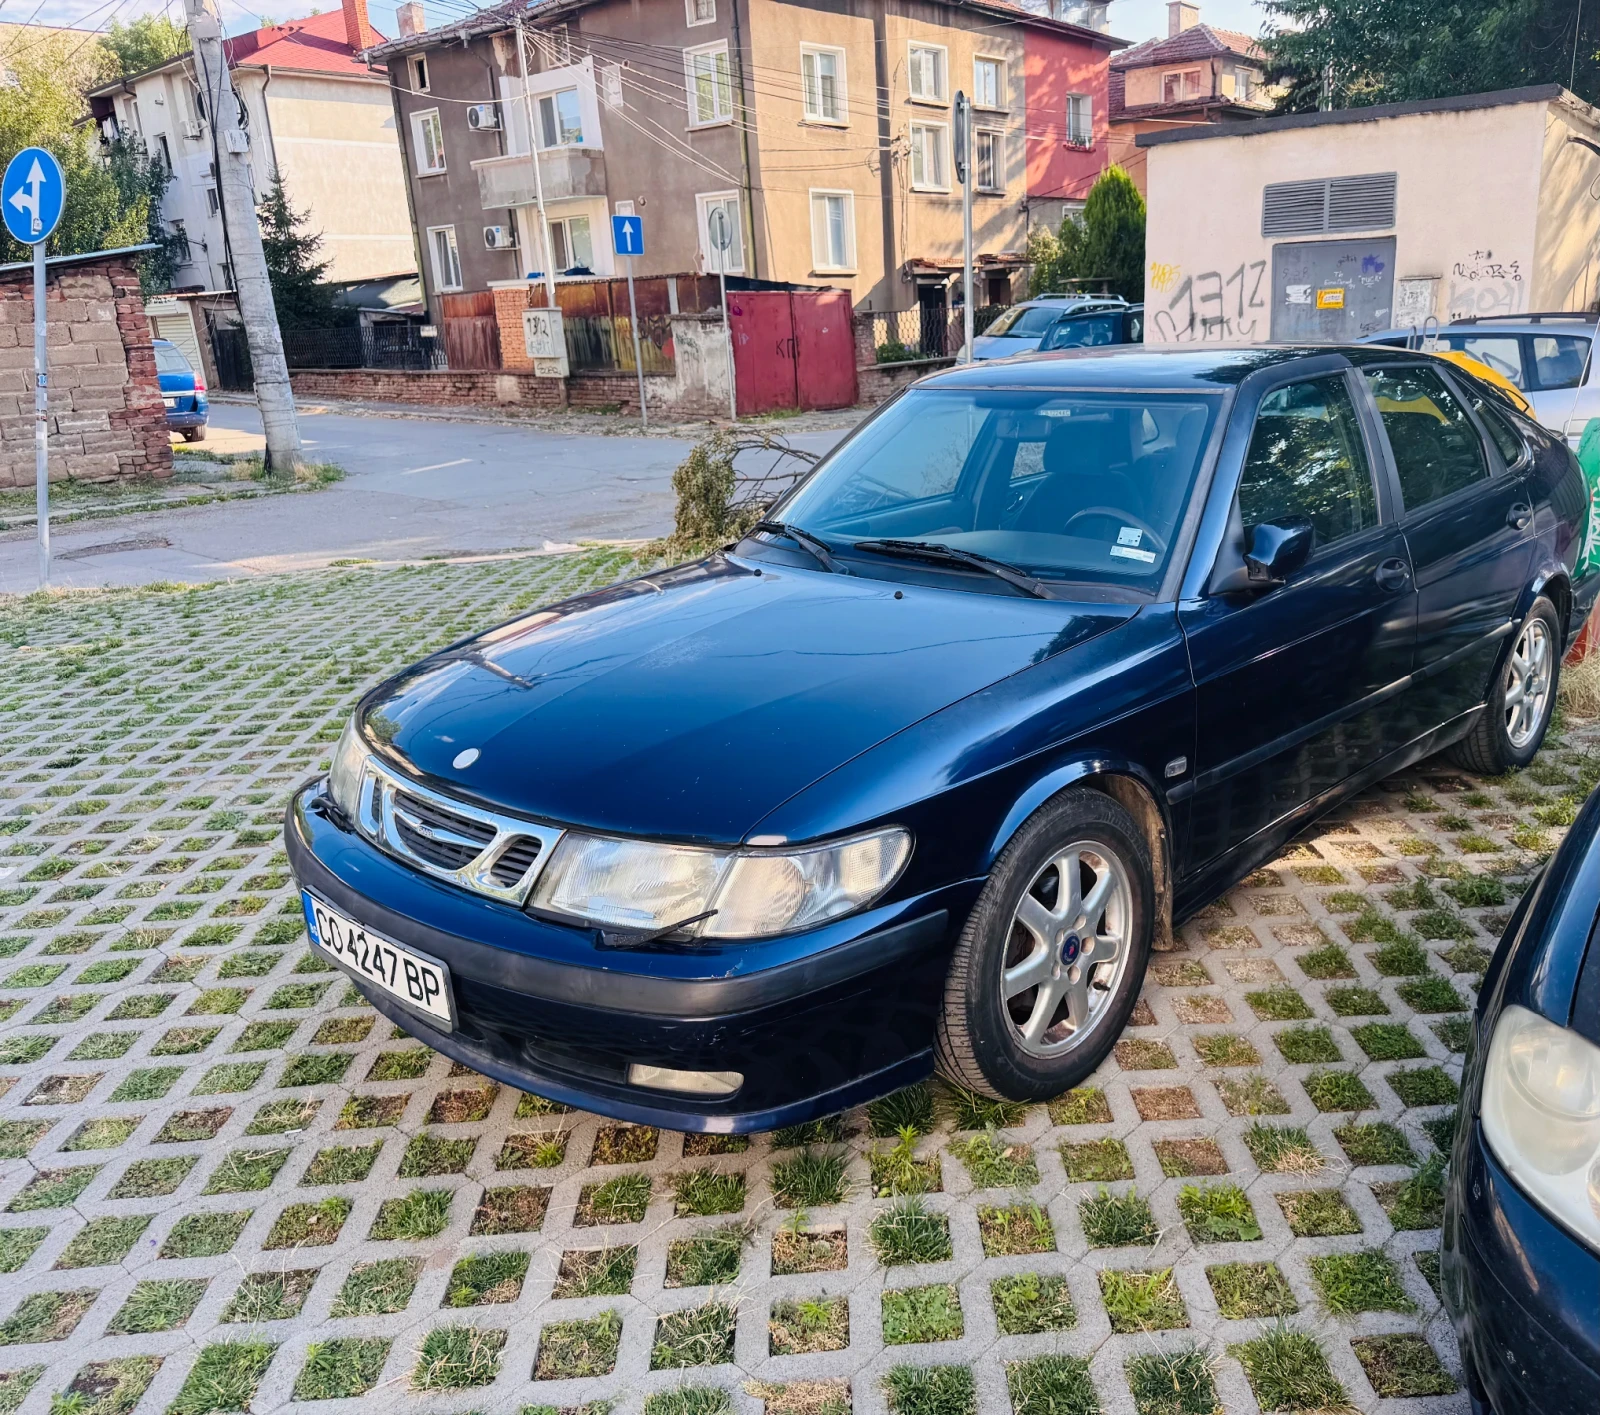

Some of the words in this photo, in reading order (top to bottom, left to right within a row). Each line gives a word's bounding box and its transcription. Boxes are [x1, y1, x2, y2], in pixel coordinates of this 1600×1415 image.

[316, 907, 344, 954] CO
[347, 928, 398, 987] 4247
[402, 957, 440, 1006] BP
